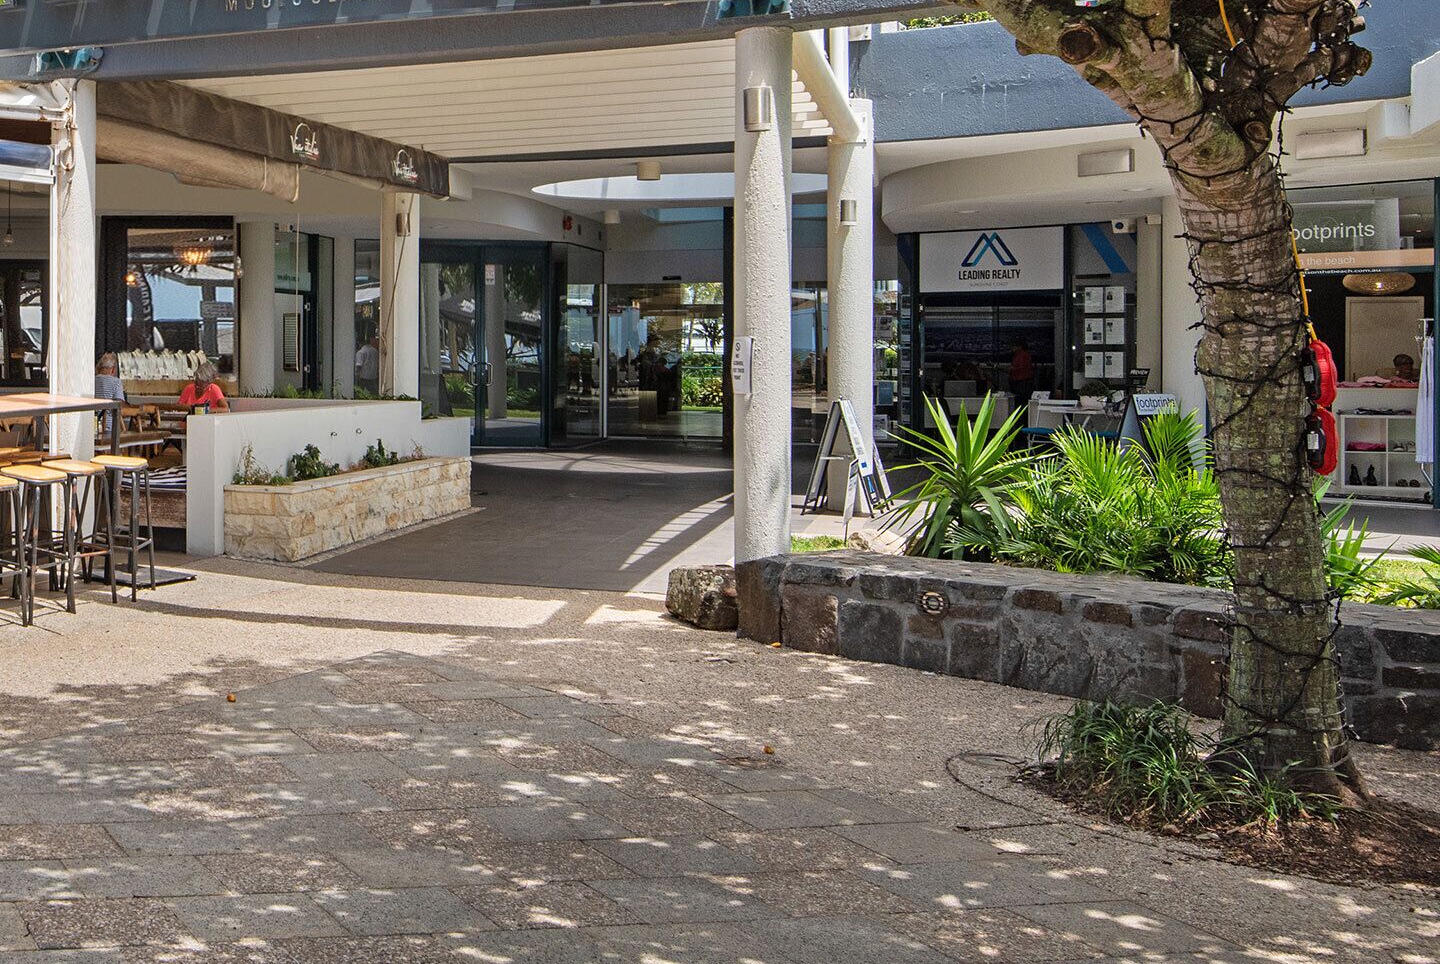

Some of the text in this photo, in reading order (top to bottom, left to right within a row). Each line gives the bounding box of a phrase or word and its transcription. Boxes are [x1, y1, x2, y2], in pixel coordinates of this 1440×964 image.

[1292, 222, 1375, 243] ootprints
[1307, 257, 1323, 266] the
[1324, 256, 1356, 265] beach
[958, 268, 1021, 281] LEADING REALTY
